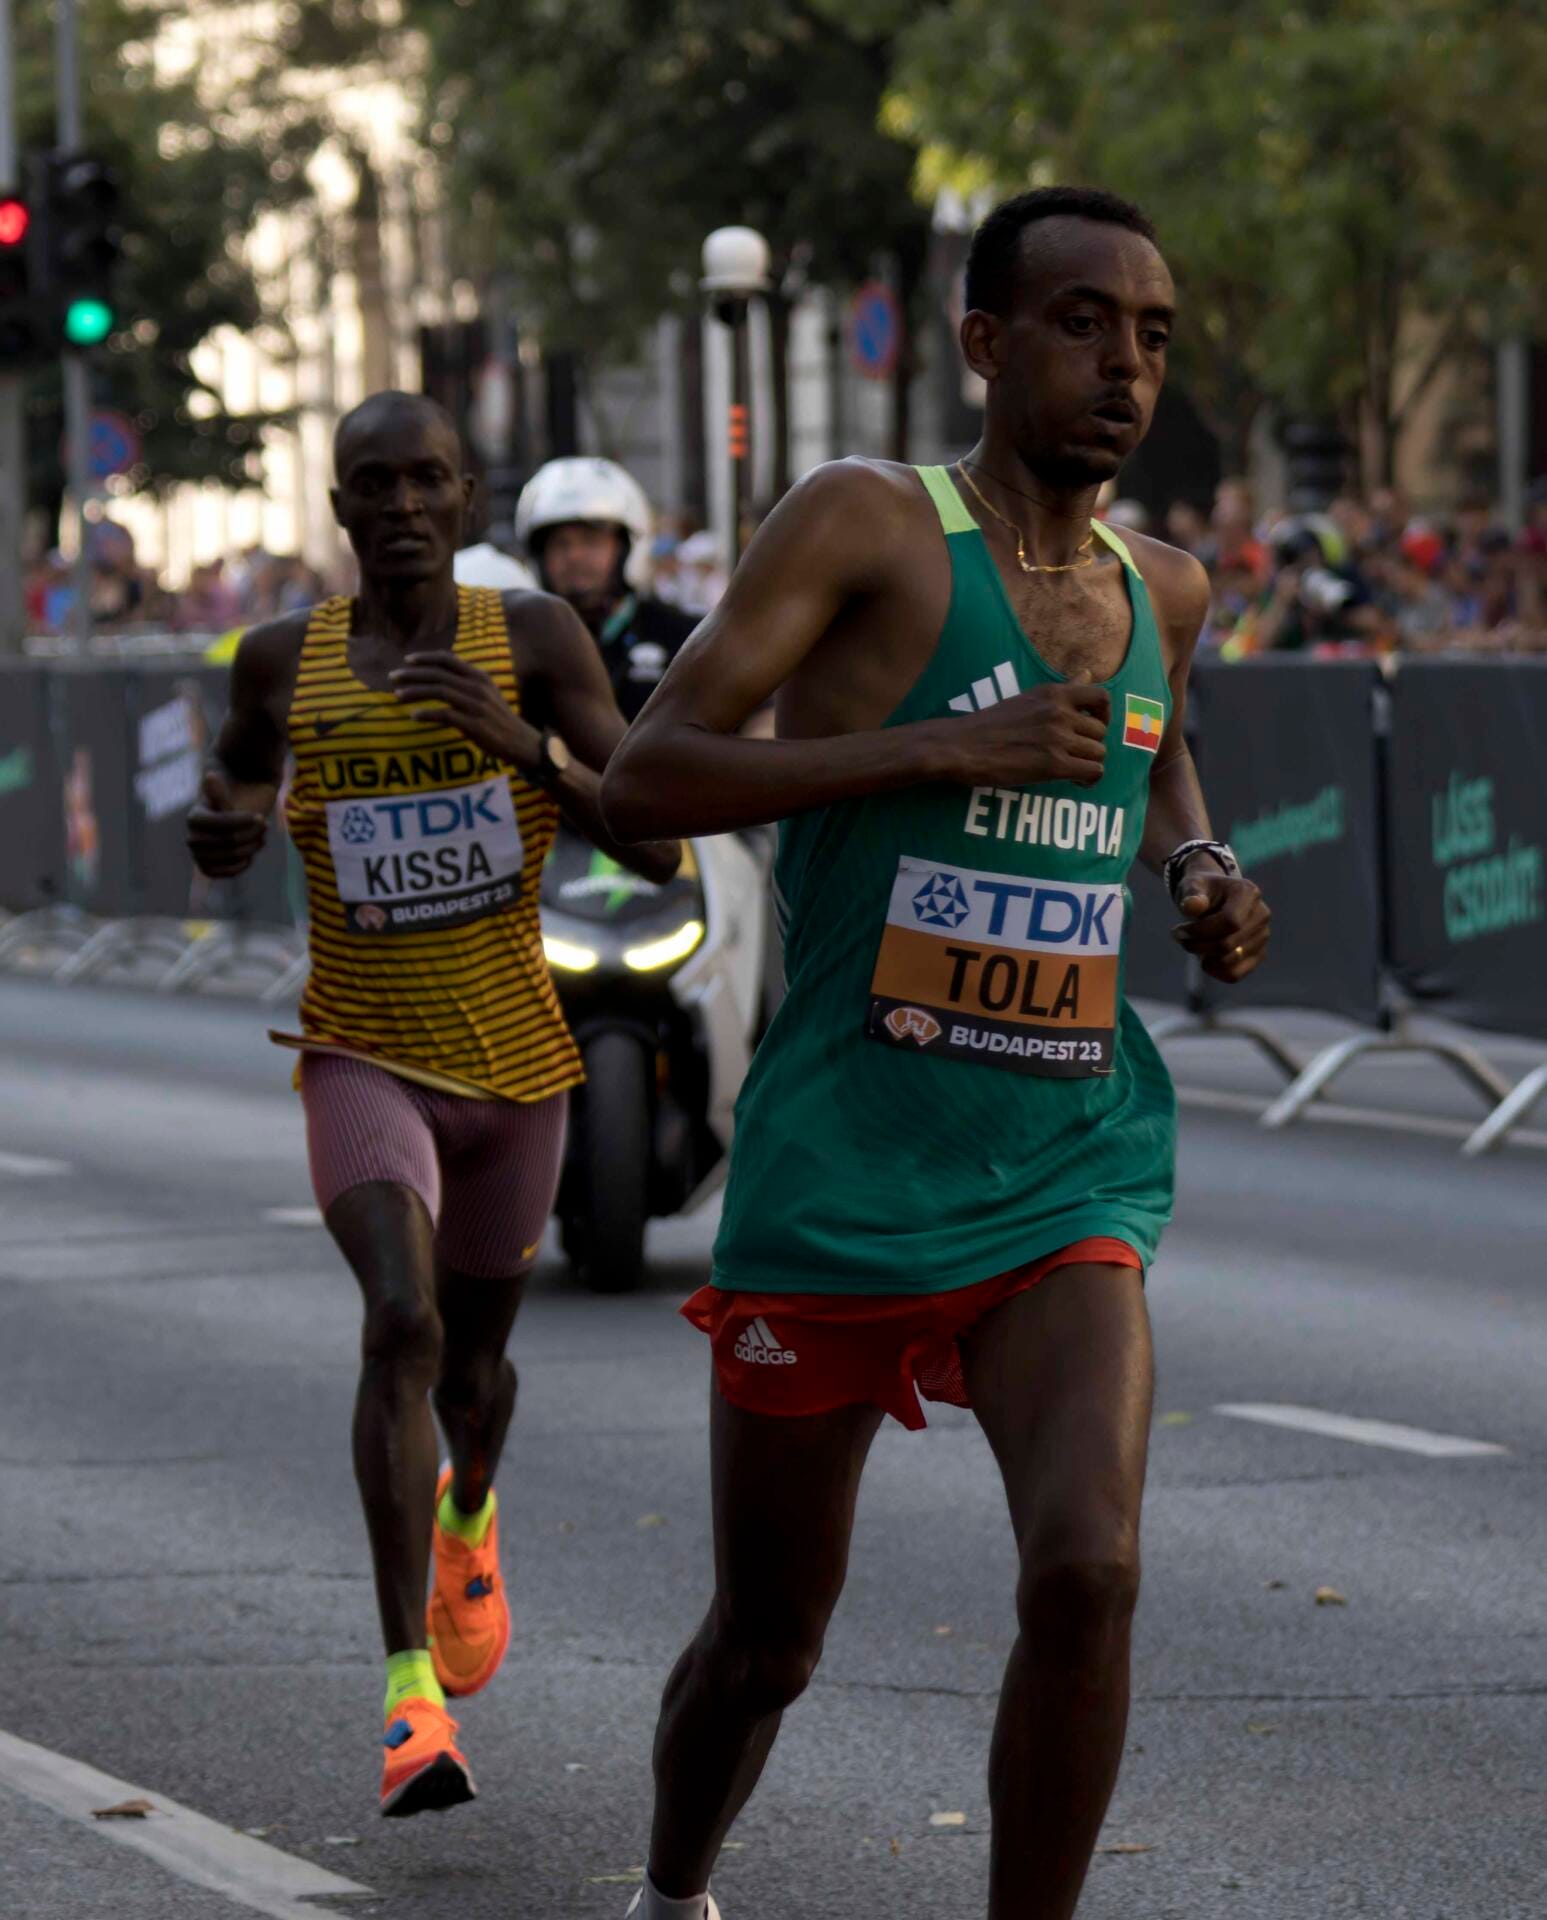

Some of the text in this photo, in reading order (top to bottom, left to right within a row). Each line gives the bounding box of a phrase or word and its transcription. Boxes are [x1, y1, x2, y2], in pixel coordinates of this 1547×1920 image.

[319, 747, 500, 790] UGANDA
[373, 786, 502, 840] TDK
[964, 786, 1124, 857] ETHIOPIA
[363, 842, 492, 896] KISSA
[973, 880, 1117, 946] TDK
[945, 947, 1080, 1019] TOLA
[734, 1343, 797, 1365] adidas
